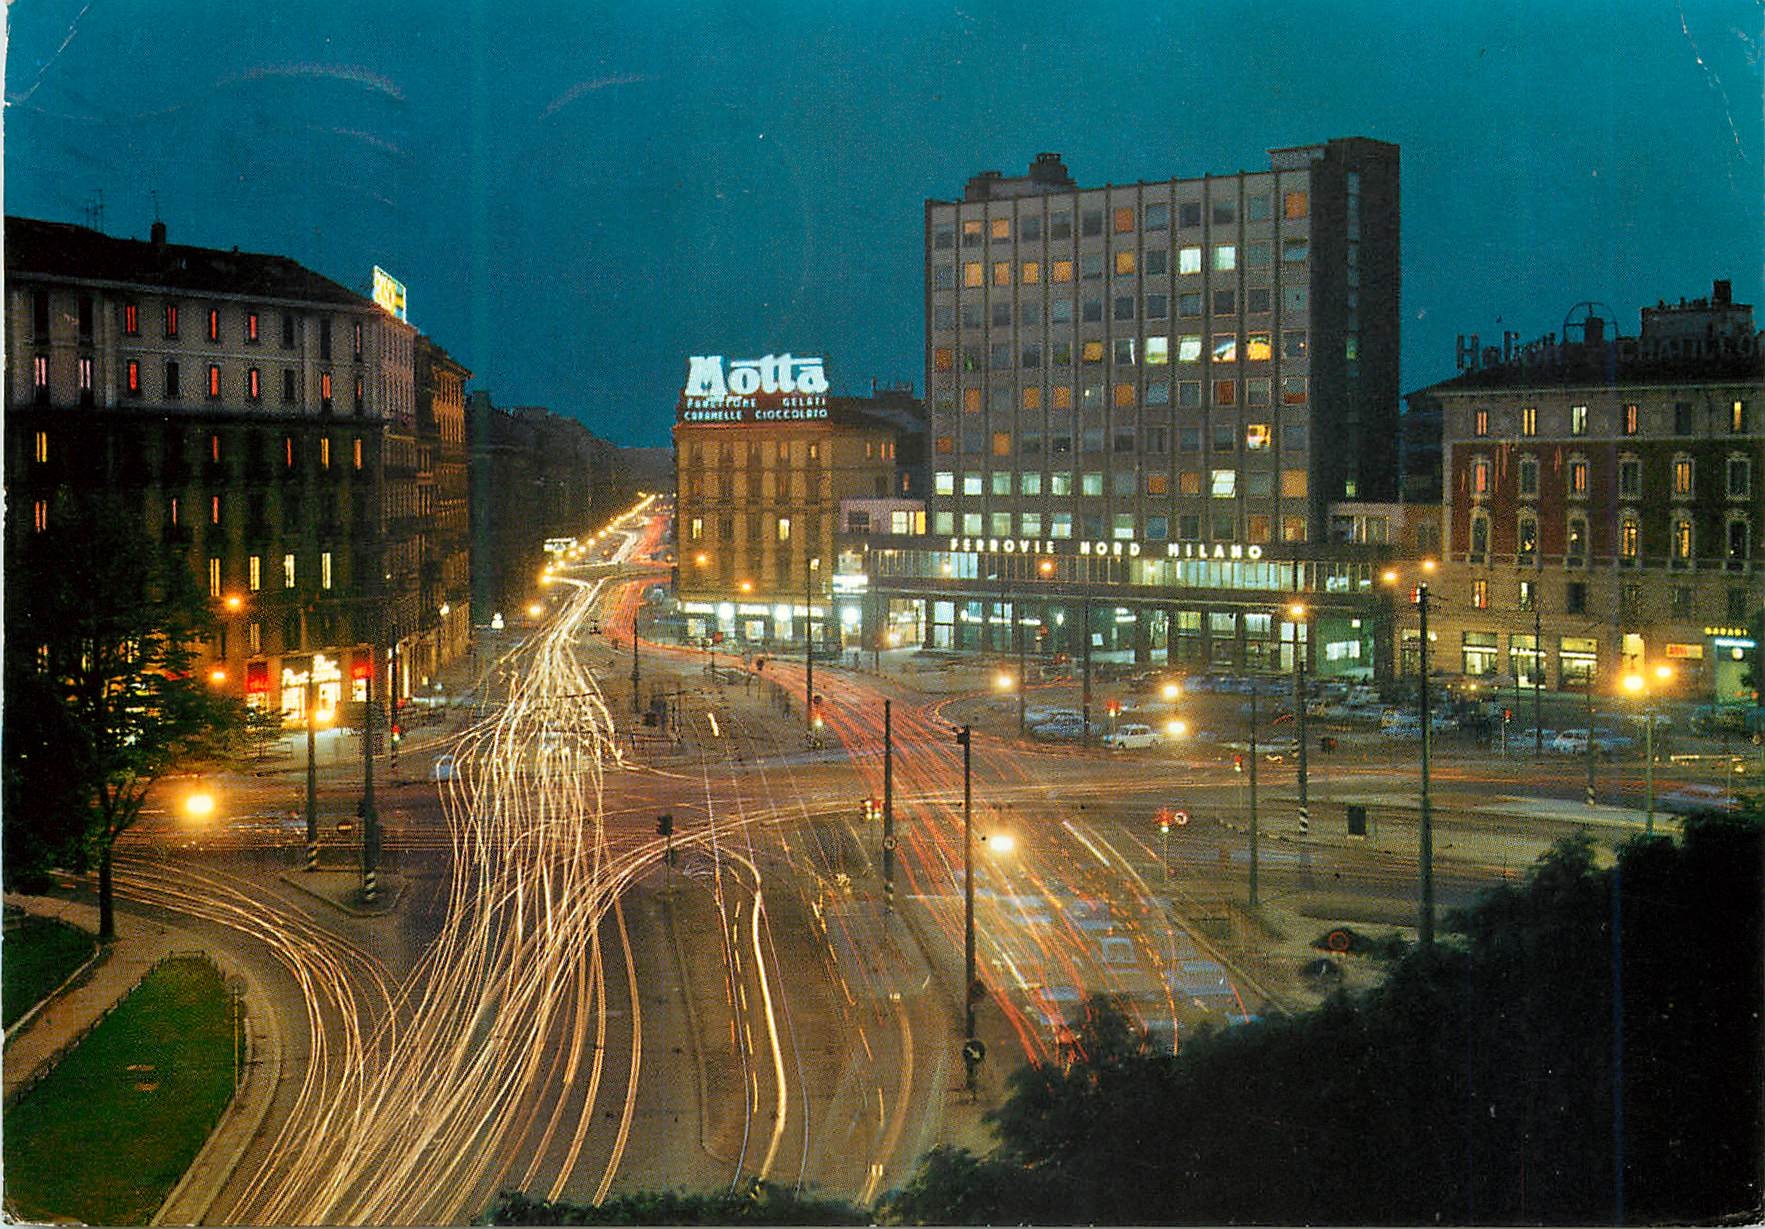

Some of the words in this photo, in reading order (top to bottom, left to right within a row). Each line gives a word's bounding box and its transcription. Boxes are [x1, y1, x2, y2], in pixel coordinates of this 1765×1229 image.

[684, 353, 829, 396] Motta
[950, 538, 1055, 554] FERROVIE
[1080, 541, 1141, 556] NORD
[1167, 542, 1263, 559] MILANO
